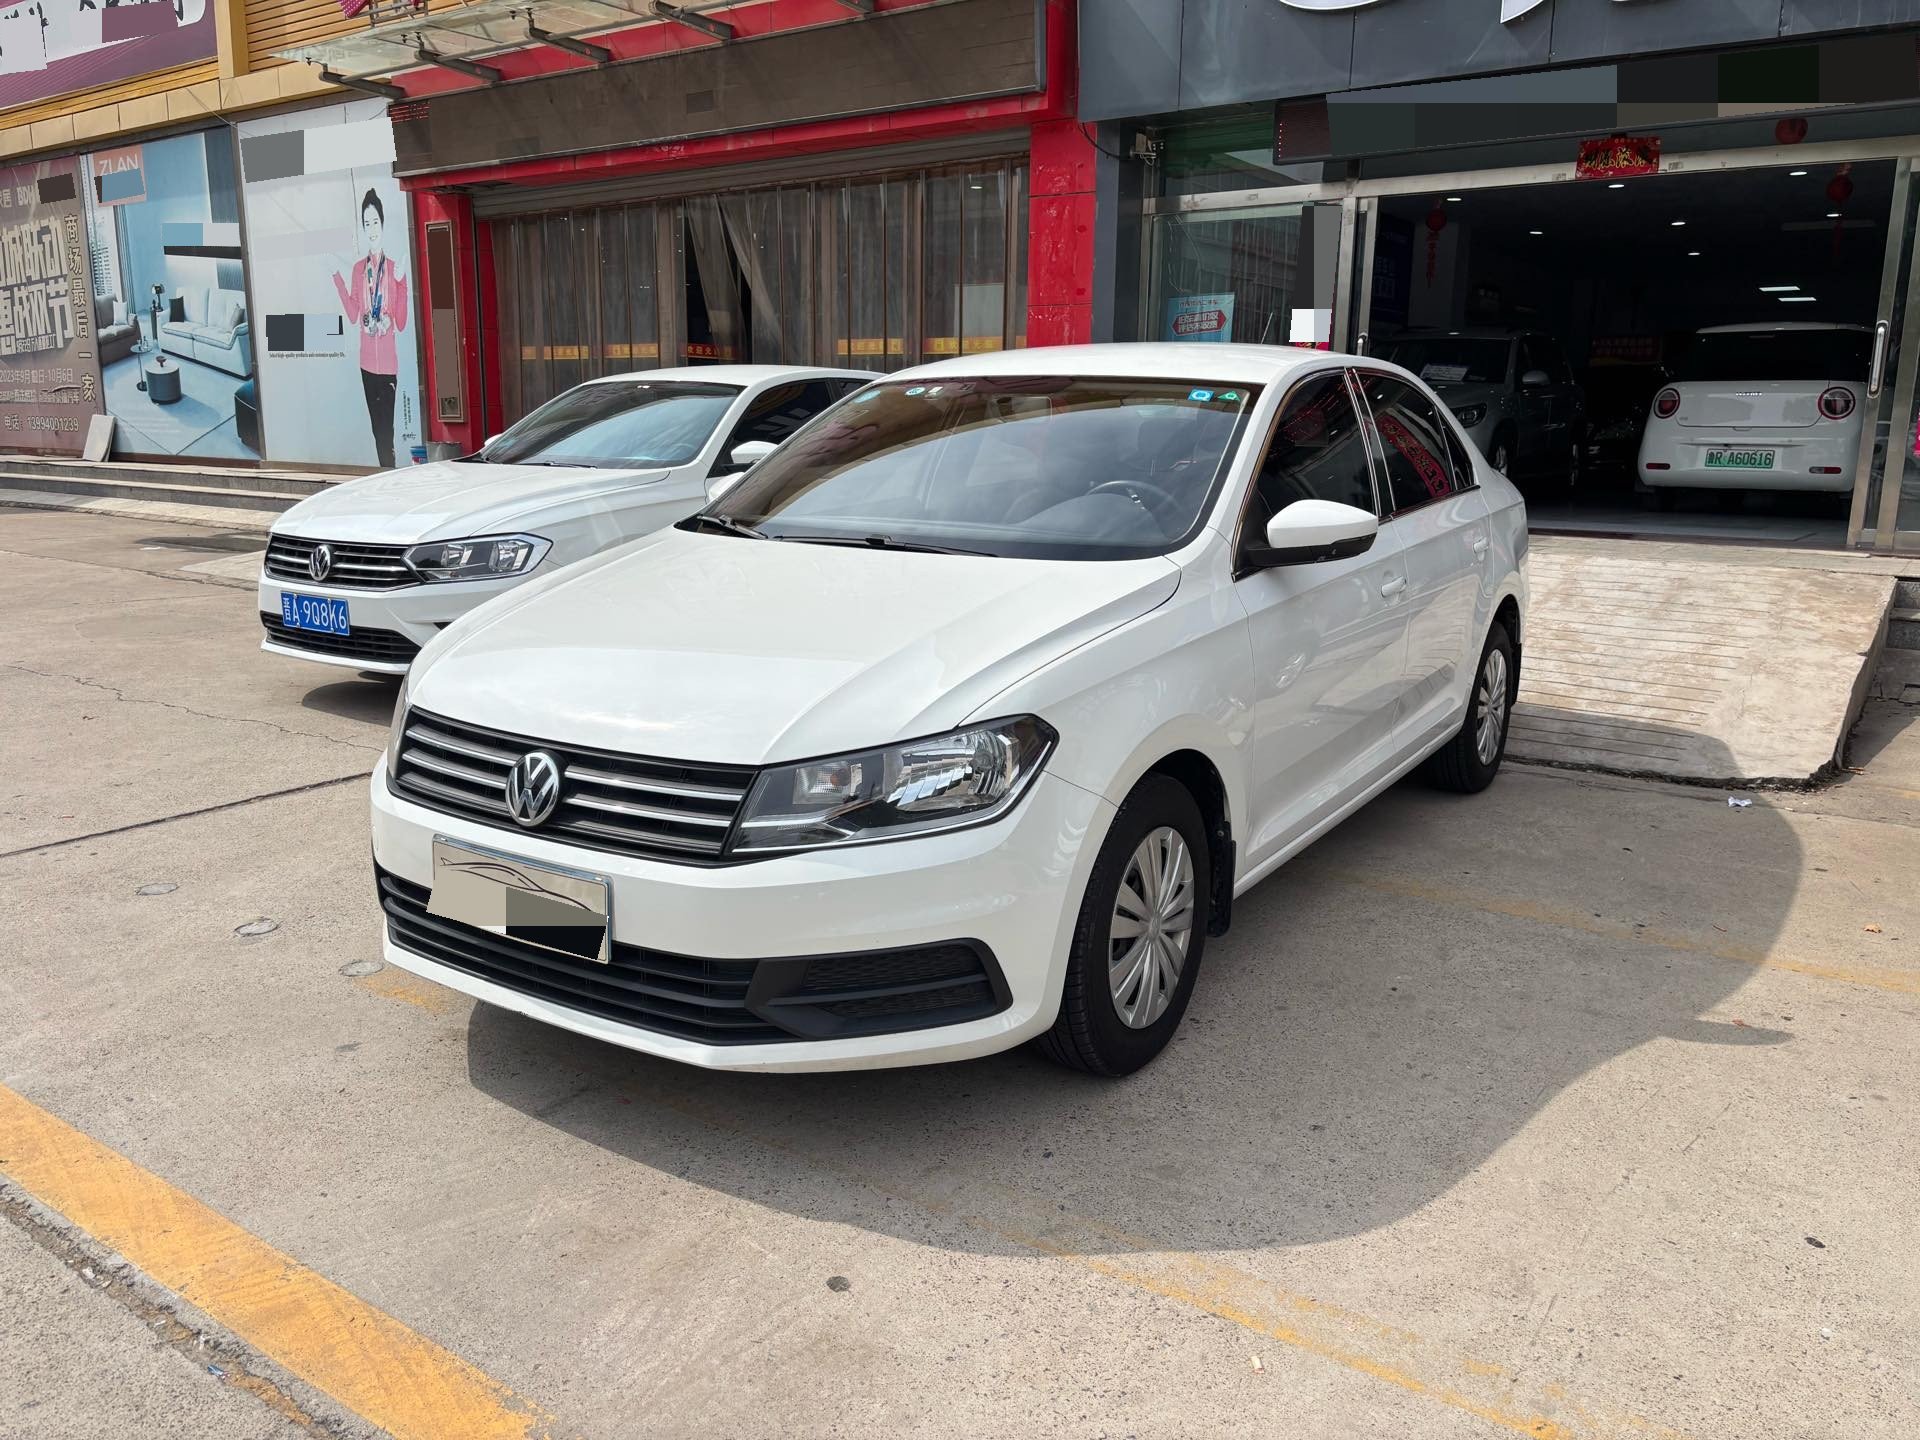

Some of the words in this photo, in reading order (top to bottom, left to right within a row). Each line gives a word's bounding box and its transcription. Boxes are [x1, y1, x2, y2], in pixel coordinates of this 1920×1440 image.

[0, 187, 12, 209] 居
[0, 215, 68, 289] 城联动
[64, 213, 97, 403] 商场最后一家
